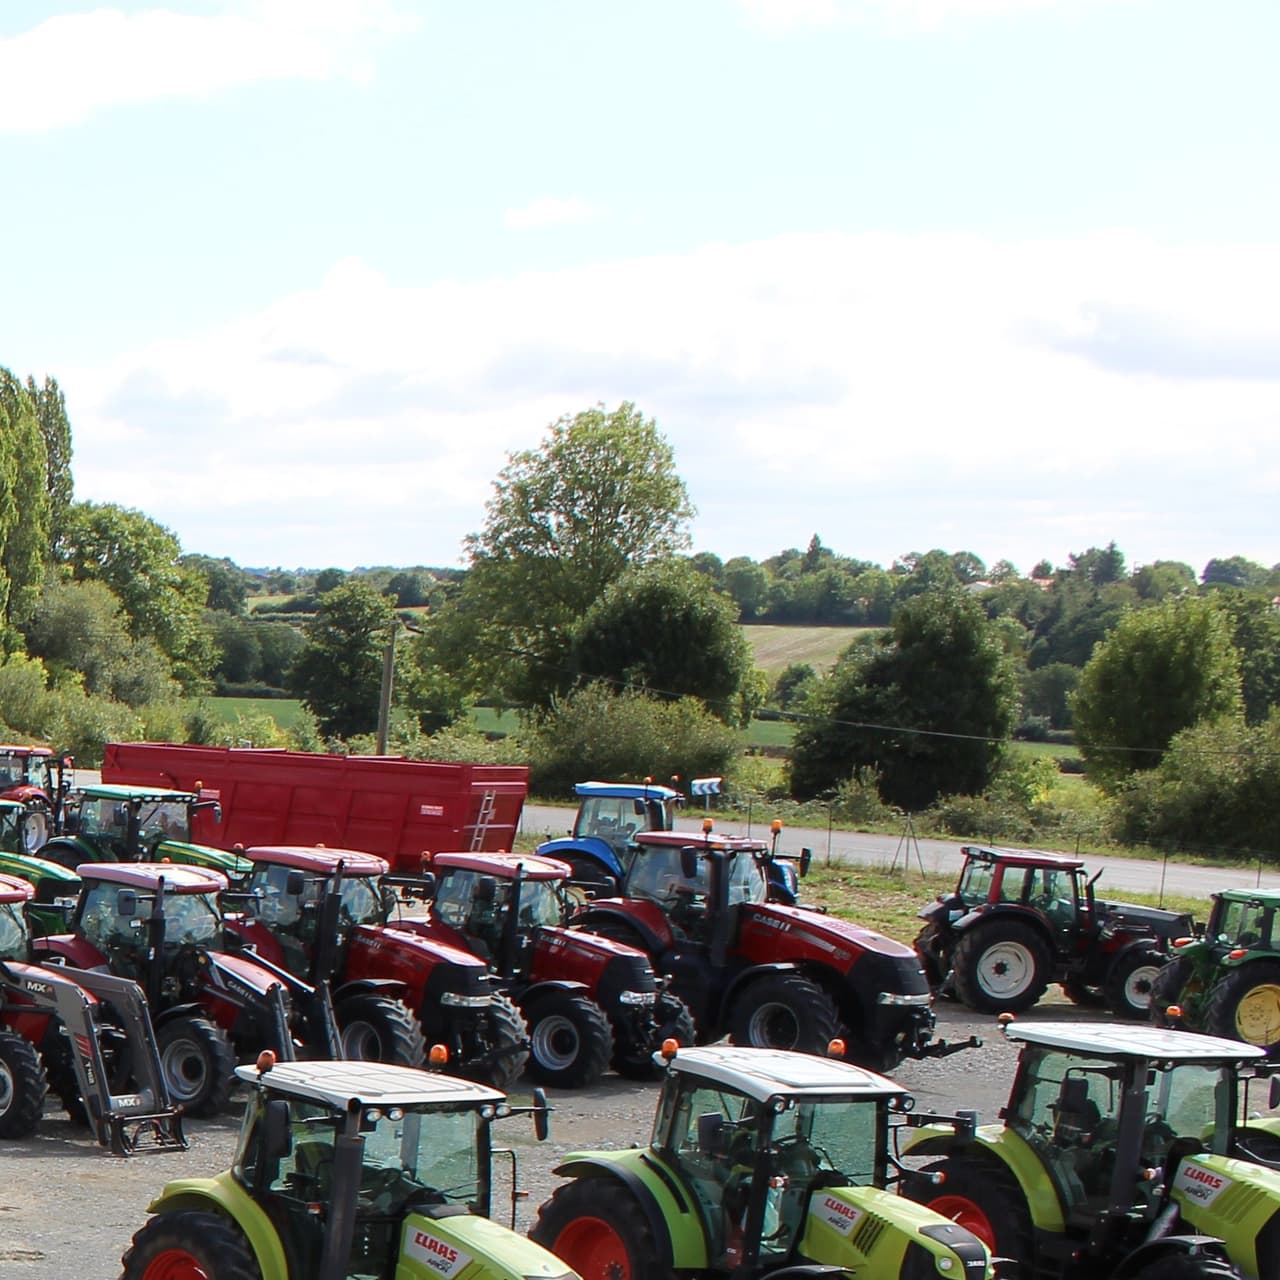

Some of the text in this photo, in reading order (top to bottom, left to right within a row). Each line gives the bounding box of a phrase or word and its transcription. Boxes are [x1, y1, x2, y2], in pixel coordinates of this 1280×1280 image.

[27, 981, 46, 992] MX
[1184, 1167, 1222, 1189] CLAAS
[824, 1198, 857, 1220] CLAAS
[415, 1232, 458, 1263] CLAAS
